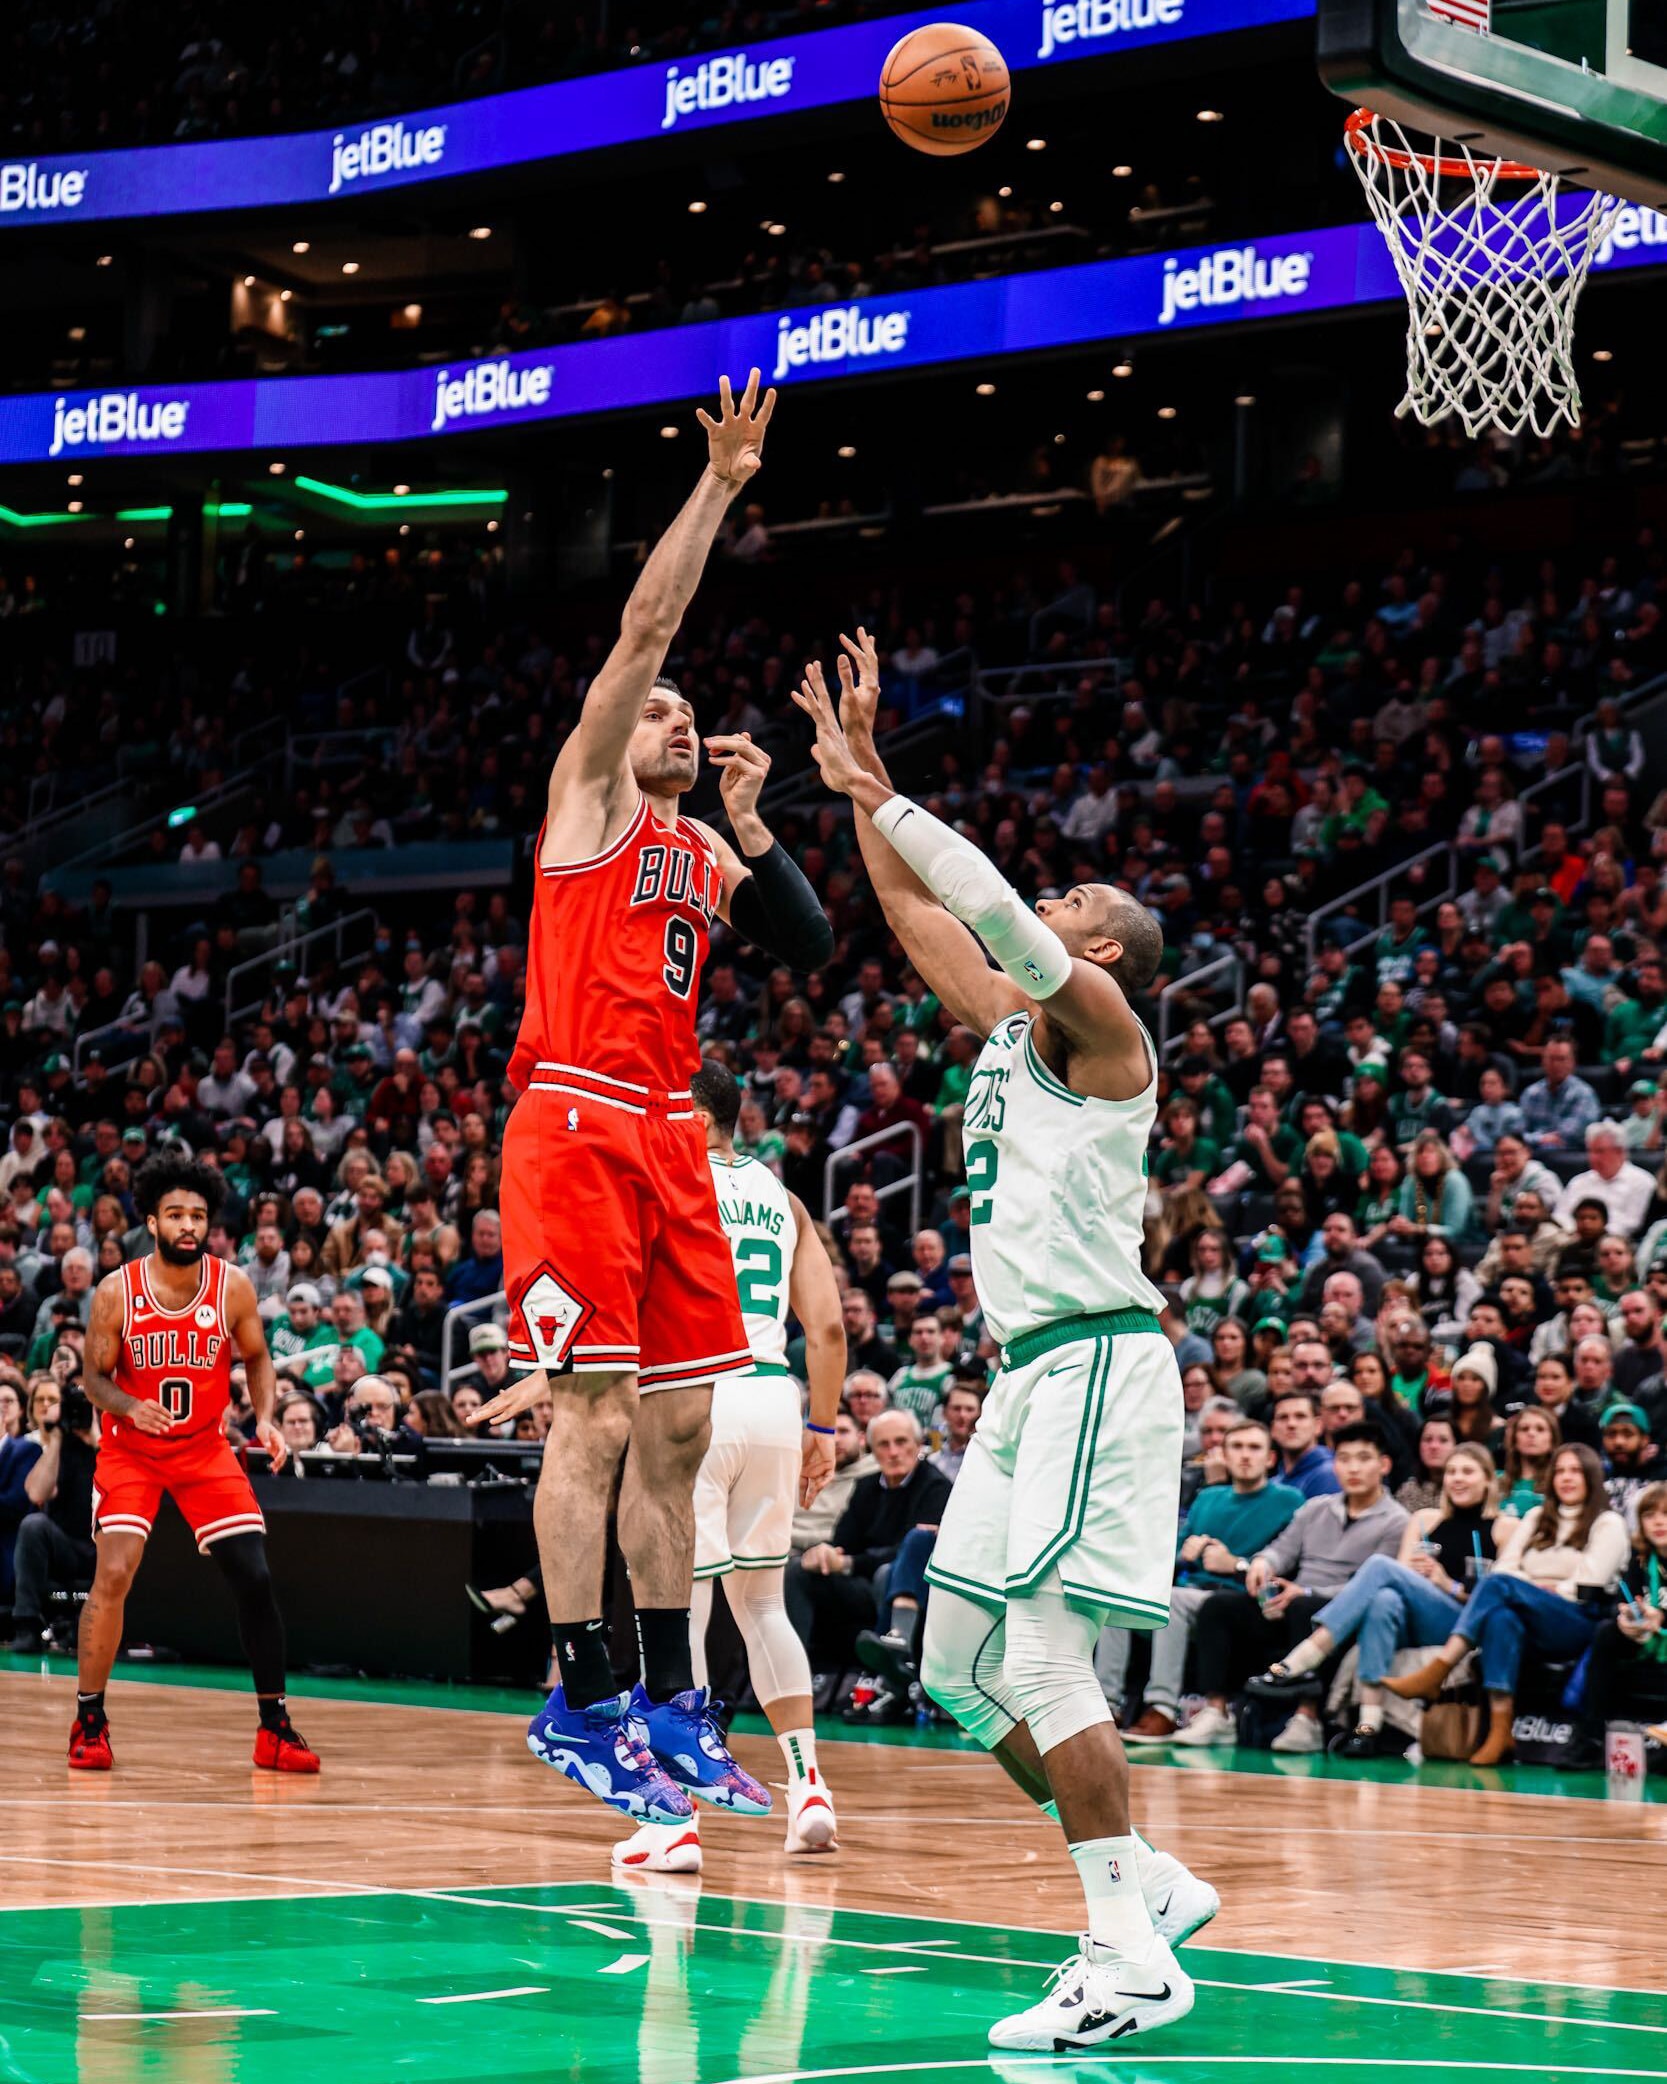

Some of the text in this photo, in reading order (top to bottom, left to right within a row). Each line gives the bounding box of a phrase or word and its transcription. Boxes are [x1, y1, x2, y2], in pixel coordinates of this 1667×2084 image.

[661, 53, 793, 129] jetBlue
[930, 99, 1006, 132] Wilson
[328, 121, 446, 193] jetBlue
[1158, 246, 1312, 325] jetBlue
[774, 306, 908, 380] jetBlue
[49, 393, 188, 456] jetBlue
[432, 360, 553, 431] jetBlue
[630, 844, 724, 928] BULL
[663, 913, 697, 1000] 9
[718, 1199, 785, 1236] ILLIAMS
[730, 1237, 782, 1320] 2
[128, 1329, 222, 1370] BULLS
[159, 1377, 193, 1425] 0
